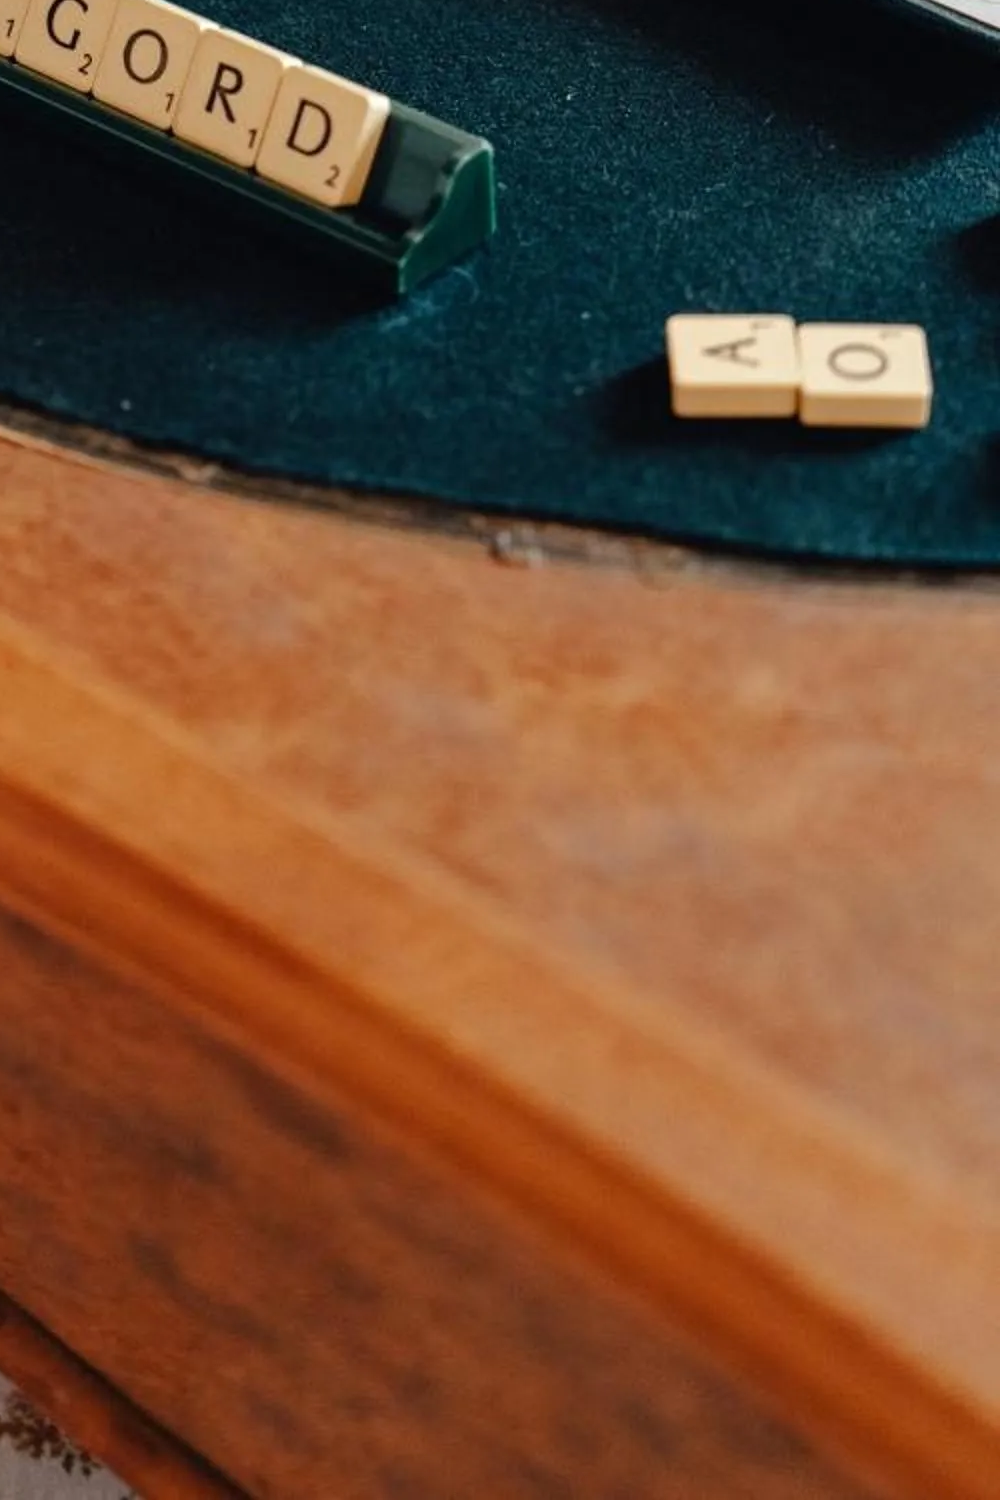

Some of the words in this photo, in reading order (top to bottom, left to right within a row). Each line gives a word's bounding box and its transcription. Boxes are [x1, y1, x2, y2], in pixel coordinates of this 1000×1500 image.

[6, 19, 15, 38] 1
[78, 53, 93, 75] 2
[165, 92, 175, 113] 1
[248, 128, 258, 150] 1
[324, 164, 341, 188] 2
[702, 336, 759, 369] A
[827, 343, 888, 381] O
